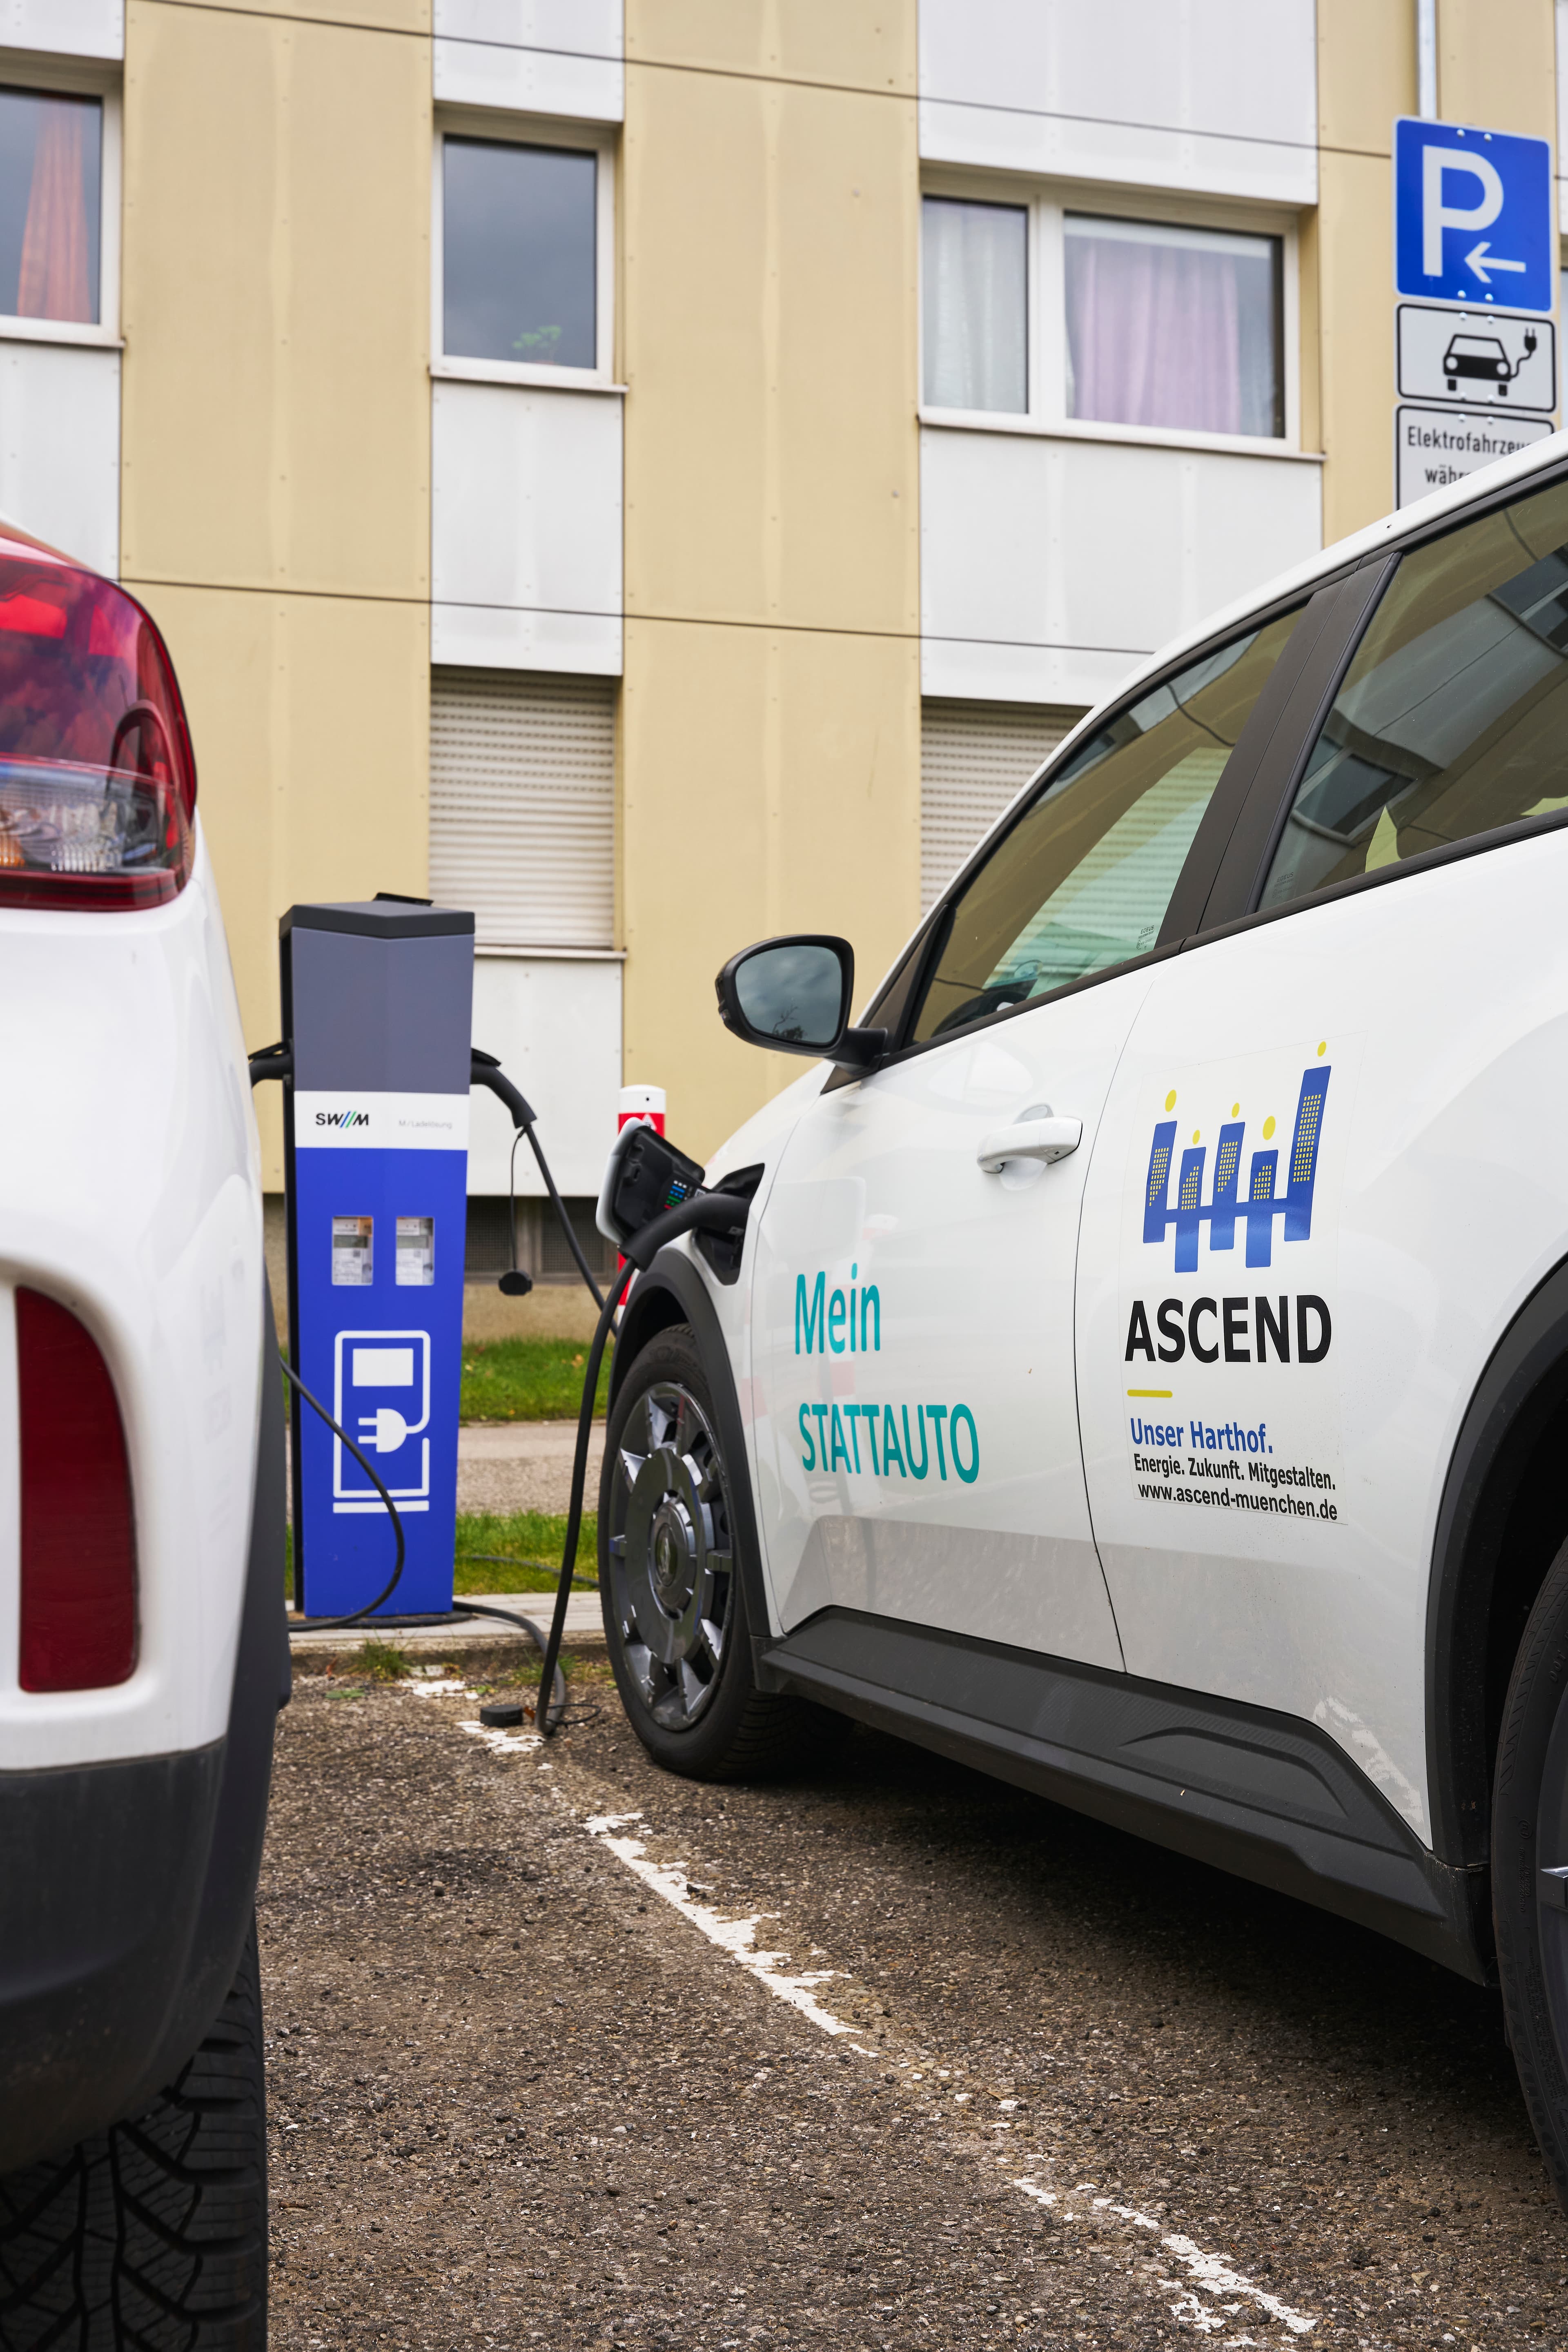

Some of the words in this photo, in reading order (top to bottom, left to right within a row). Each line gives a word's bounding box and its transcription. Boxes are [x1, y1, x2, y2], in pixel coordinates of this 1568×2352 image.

[1423, 145, 1504, 277] P
[1140, 925, 1154, 934] EGEUS
[795, 1263, 880, 1354] Mein
[1125, 1295, 1332, 1363] ASCEND
[799, 1403, 979, 1483] STATTAUTO
[1130, 1418, 1183, 1447] Unser
[1190, 1421, 1273, 1453] Harthof.
[1134, 1453, 1185, 1478] Energie.
[1188, 1457, 1245, 1480] Zukunft.
[1248, 1462, 1336, 1490] Mitgestalten.
[1138, 1483, 1337, 1520] www.ascend-muenchen.de
